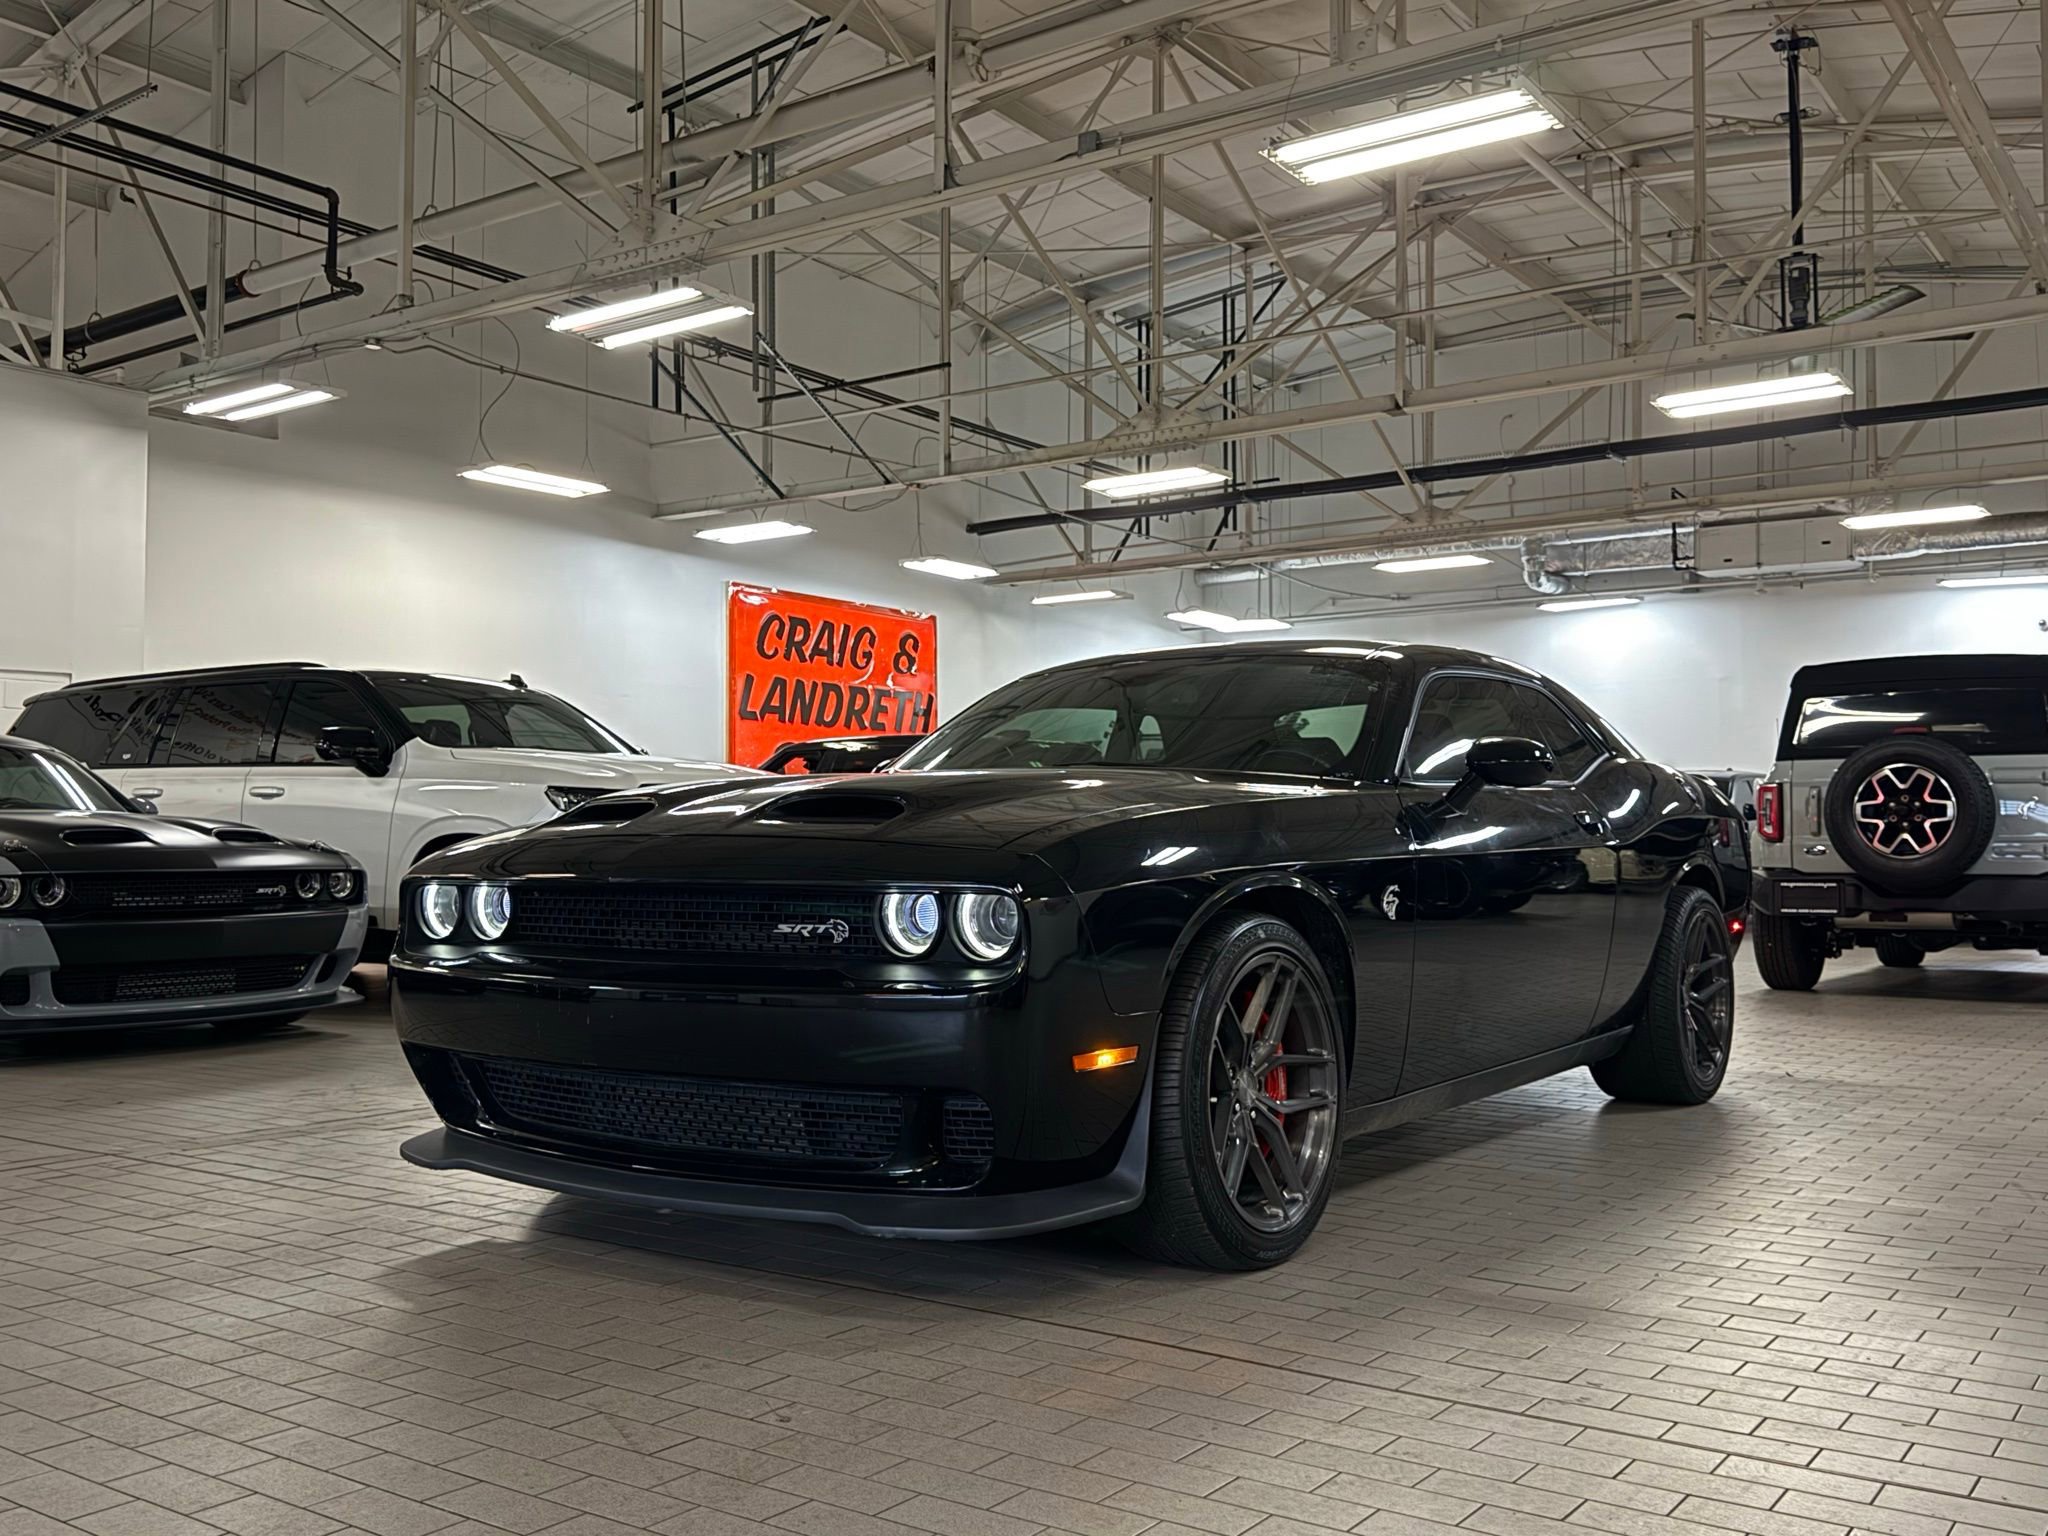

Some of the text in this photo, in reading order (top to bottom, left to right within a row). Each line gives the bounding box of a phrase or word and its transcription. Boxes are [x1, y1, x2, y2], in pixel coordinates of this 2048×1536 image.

[756, 614, 920, 675] CRAIG &
[738, 673, 934, 733] LANDRETH
[772, 923, 834, 937] SRT
